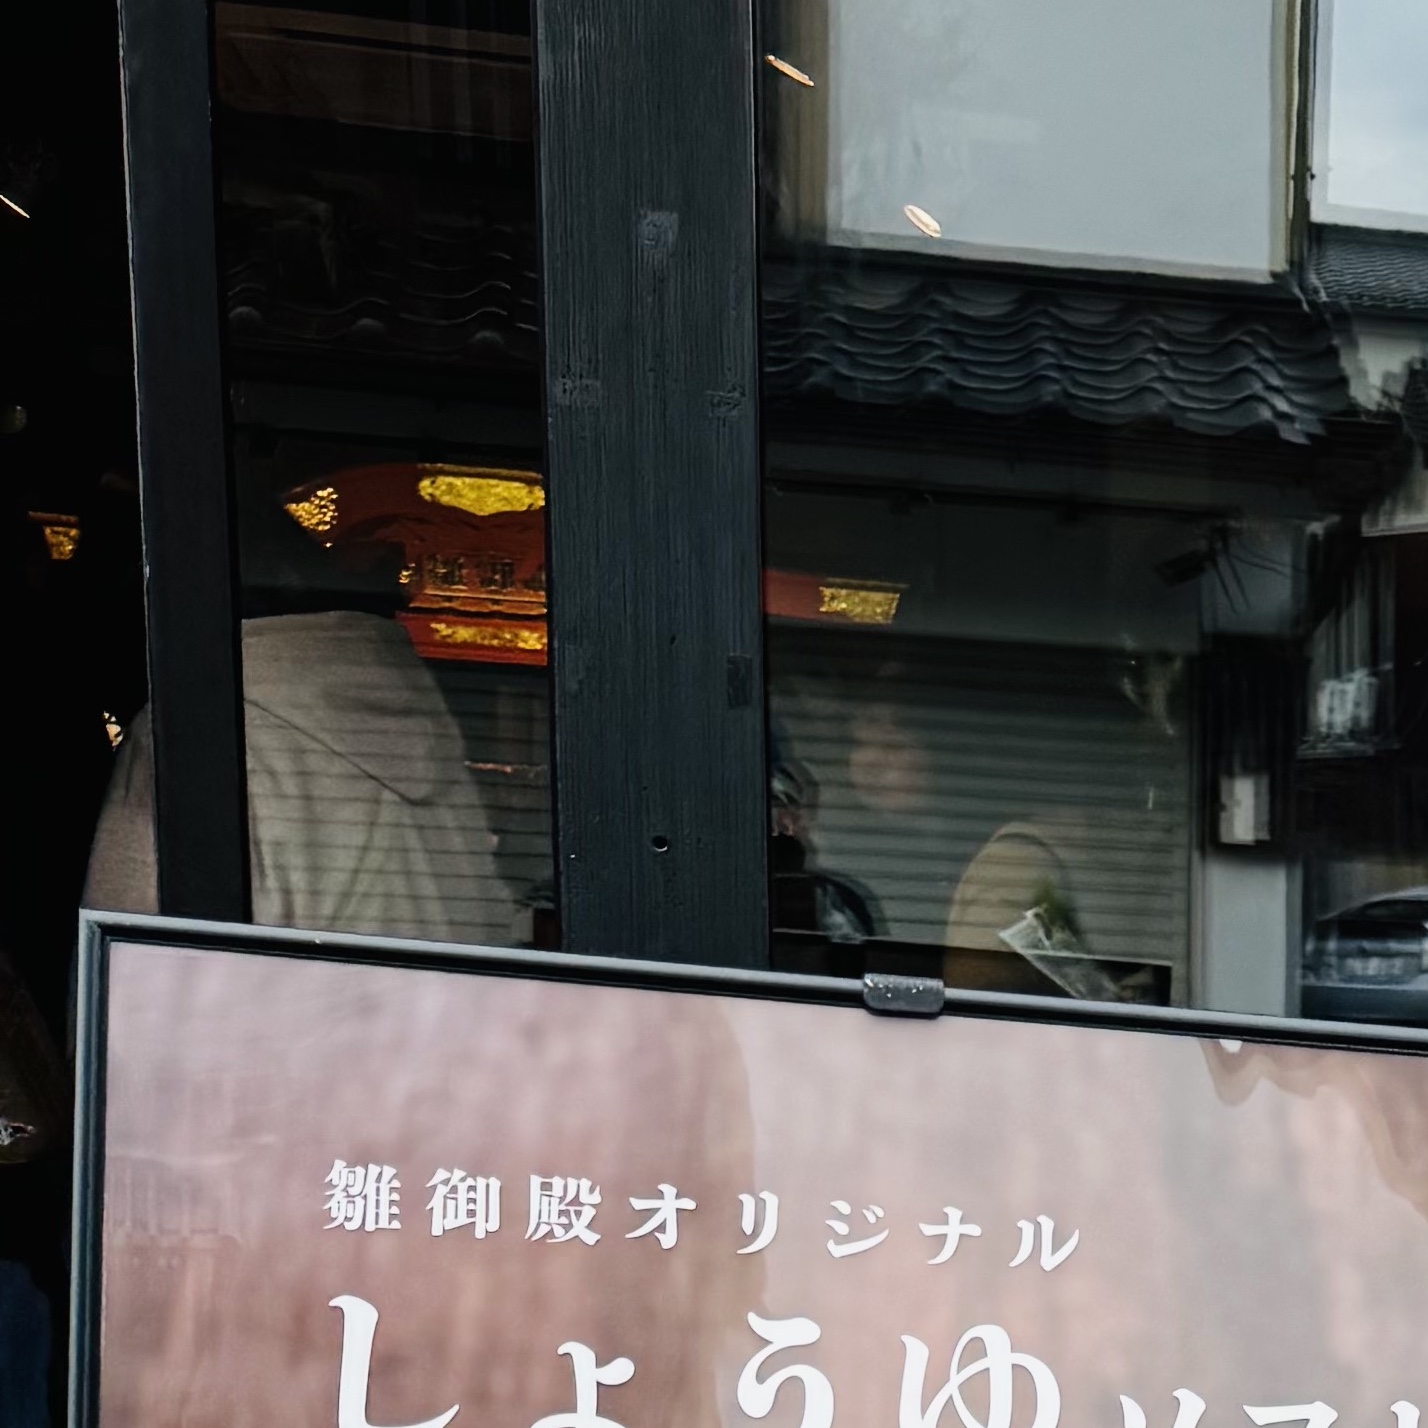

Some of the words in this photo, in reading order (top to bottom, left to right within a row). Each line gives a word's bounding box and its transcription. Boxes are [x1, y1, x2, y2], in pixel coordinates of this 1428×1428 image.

[322, 1157, 1082, 1274] 雛御殿オリジナル
